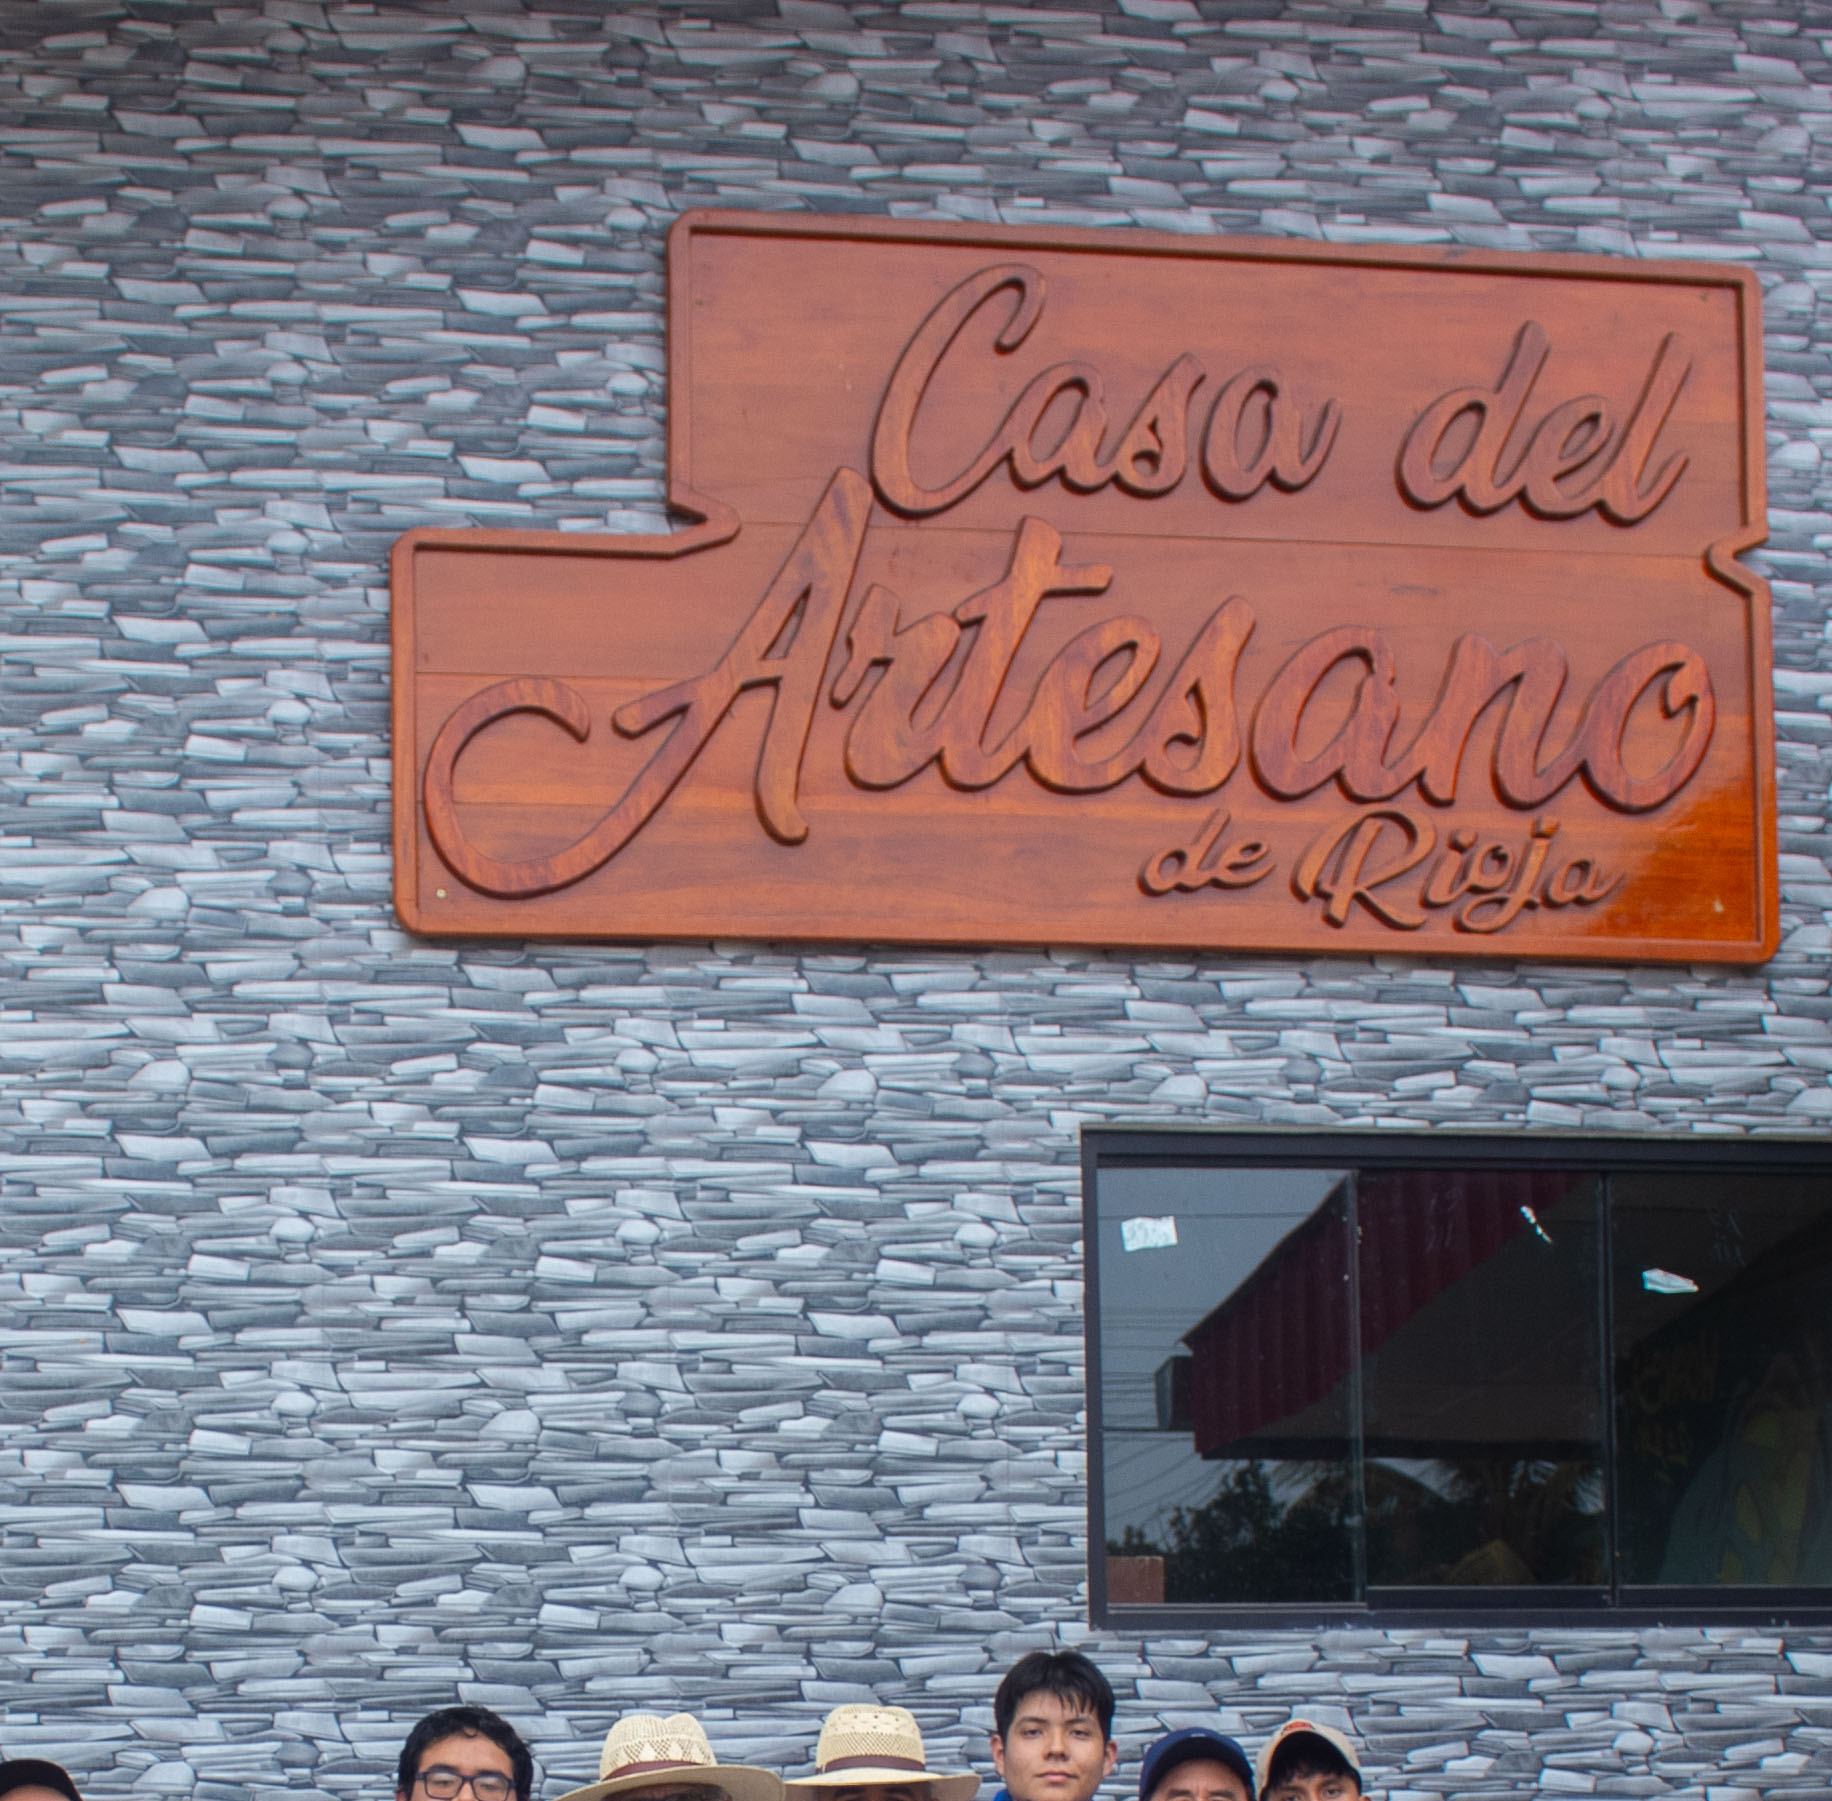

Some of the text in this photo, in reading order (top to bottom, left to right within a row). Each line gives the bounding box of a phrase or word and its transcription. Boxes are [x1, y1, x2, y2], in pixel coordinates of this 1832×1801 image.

[868, 262, 1696, 527] Casa del
[423, 466, 1719, 902] Artesano
[1138, 809, 1624, 934] de Rioja
